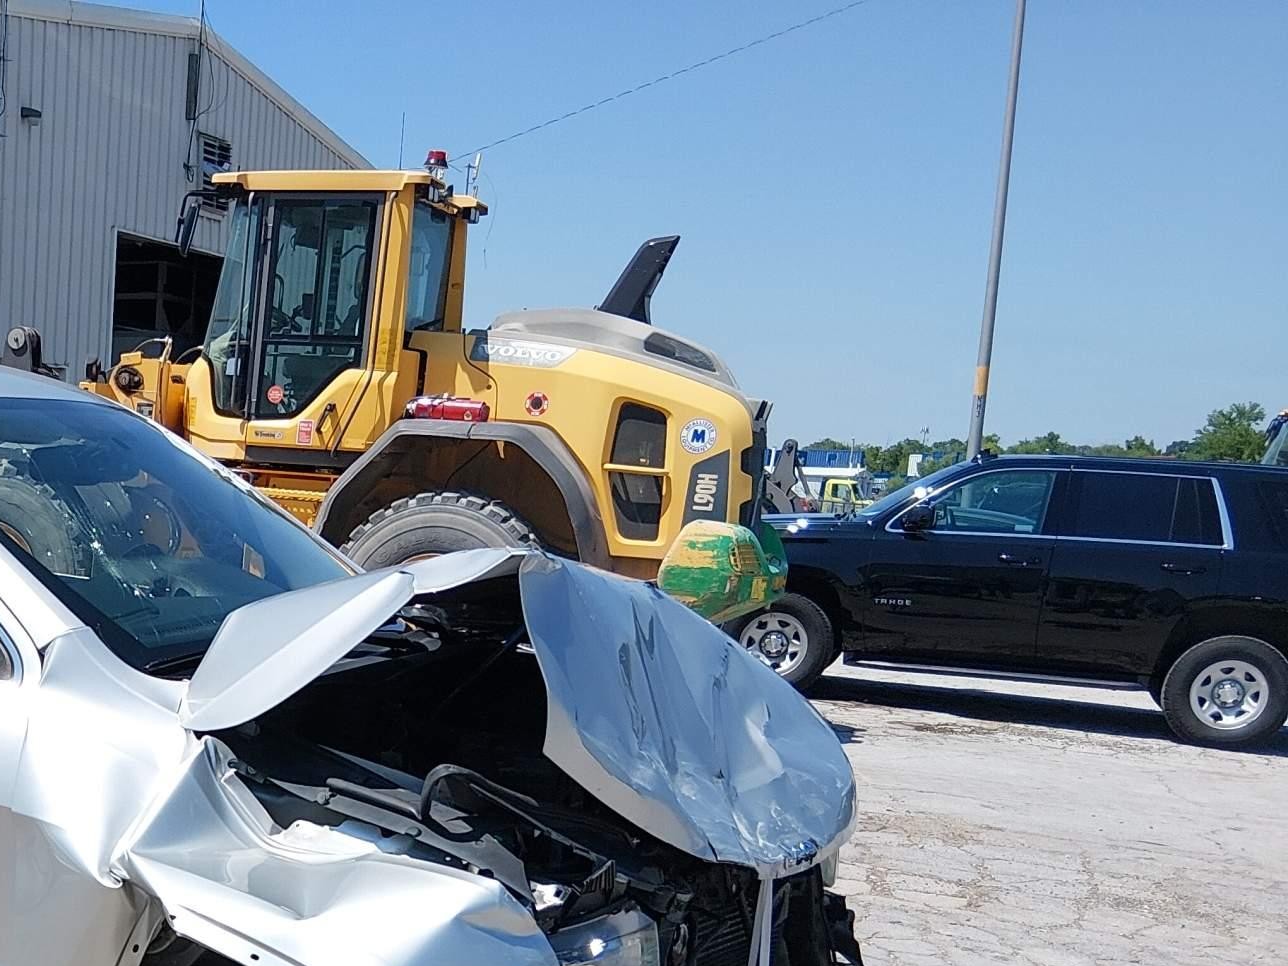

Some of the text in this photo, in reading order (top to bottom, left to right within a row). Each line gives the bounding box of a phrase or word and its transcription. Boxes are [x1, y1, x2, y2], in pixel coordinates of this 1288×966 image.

[480, 344, 561, 361] VOLVO
[691, 429, 706, 443] M
[692, 473, 718, 511] L90H
[873, 598, 912, 606] TAHOE
